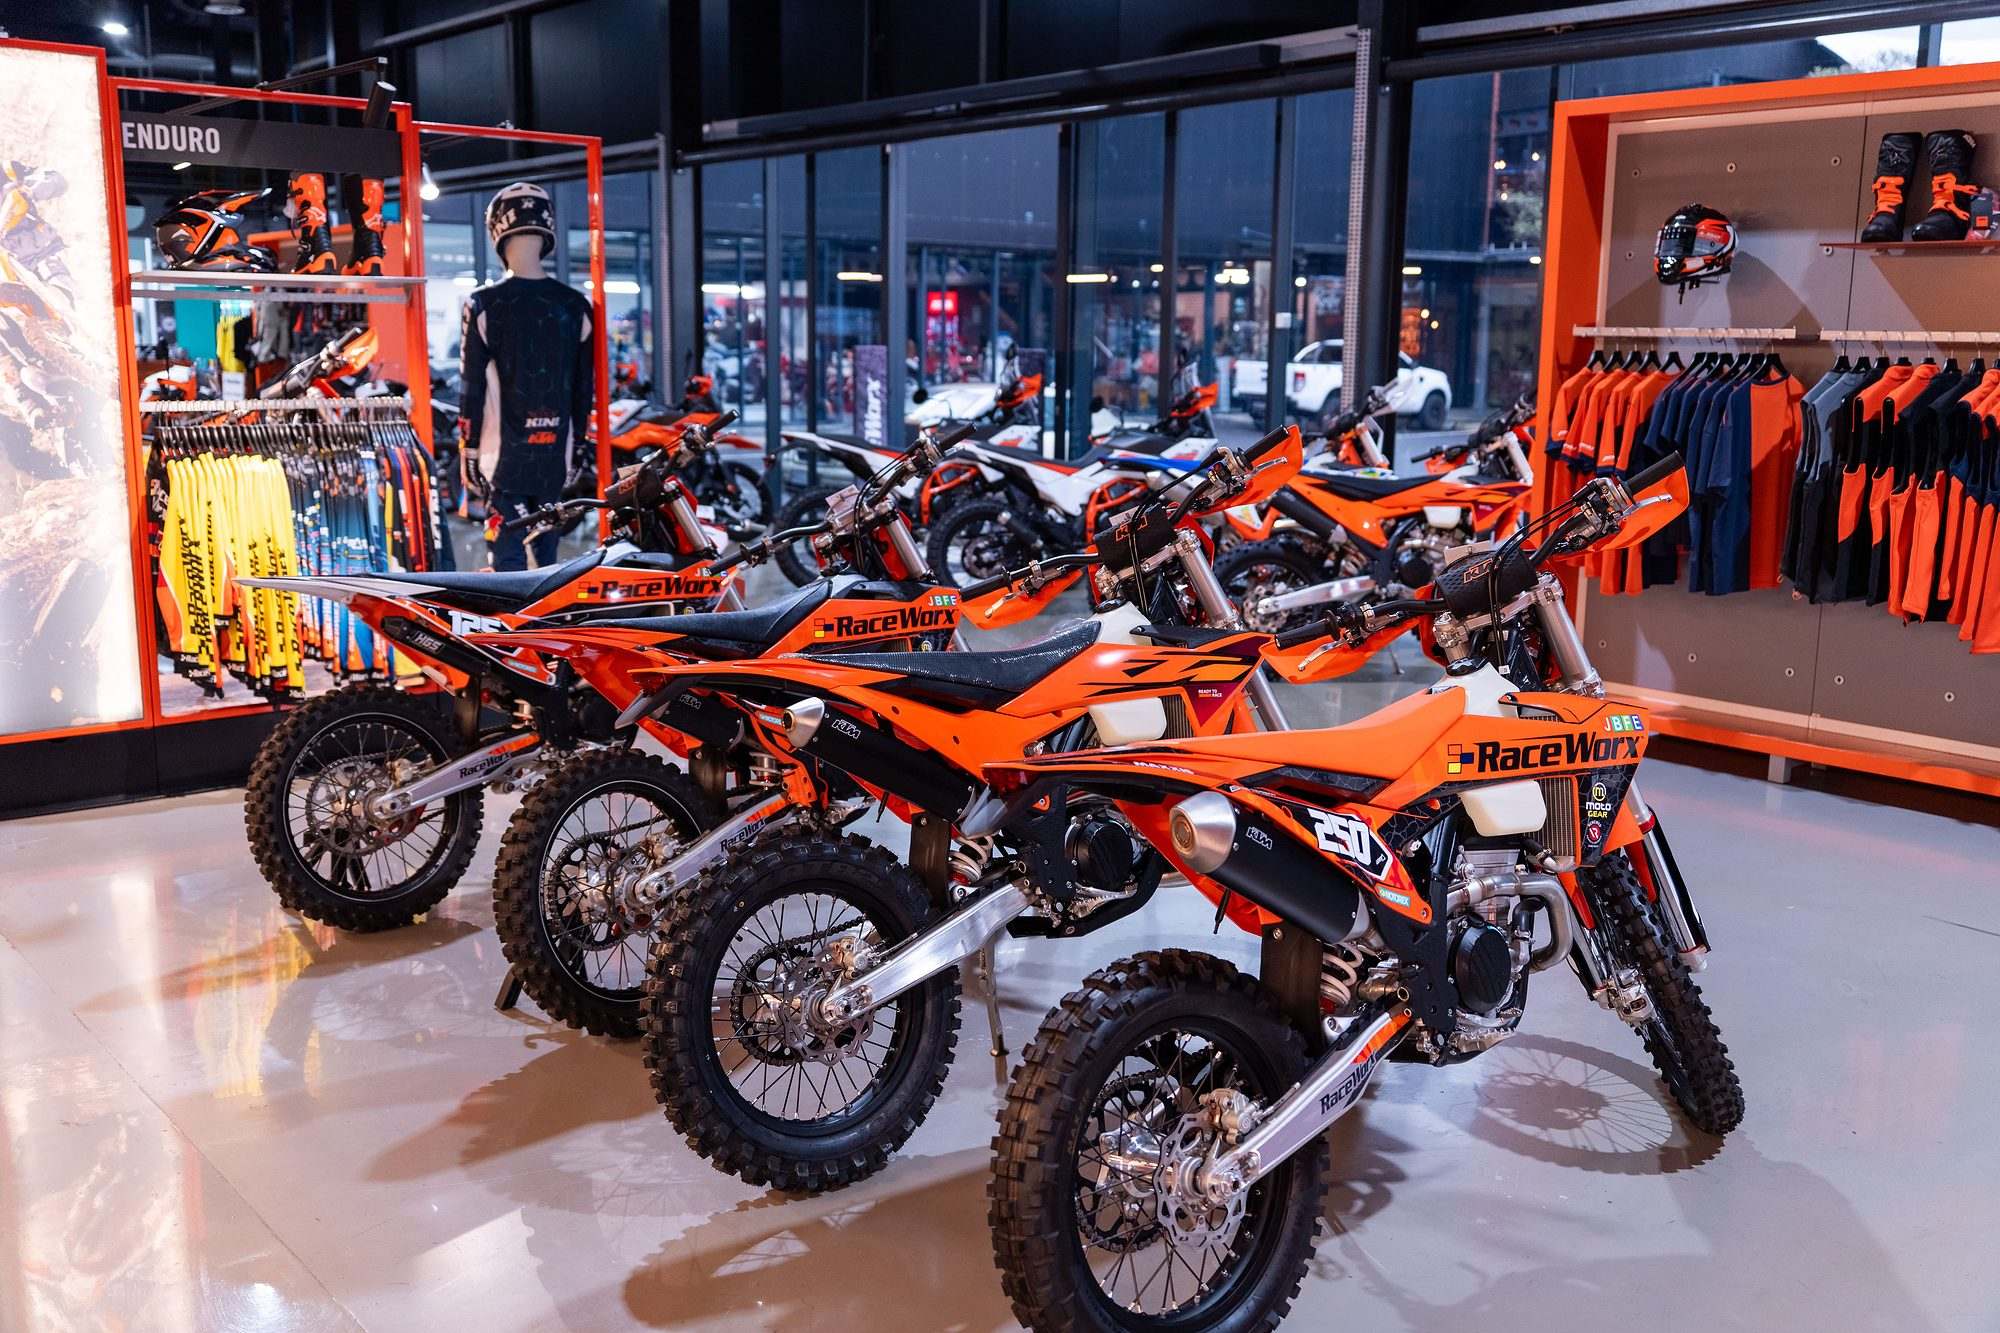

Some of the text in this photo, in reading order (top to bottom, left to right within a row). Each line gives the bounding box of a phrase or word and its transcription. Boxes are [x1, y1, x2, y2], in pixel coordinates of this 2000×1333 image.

[121, 121, 221, 154] ENDURO
[600, 576, 722, 599] RaceWorx
[928, 595, 957, 606] JBFE
[834, 606, 956, 637] RaceWorx
[414, 633, 442, 651] HGS
[680, 694, 702, 709] KTM
[832, 719, 861, 739] KTM
[1604, 714, 1644, 732] JBFE
[1473, 731, 1640, 773] RaceWorx
[1587, 810, 1608, 818] GEAR
[1246, 826, 1273, 850] KTM
[1307, 808, 1371, 866] 250
